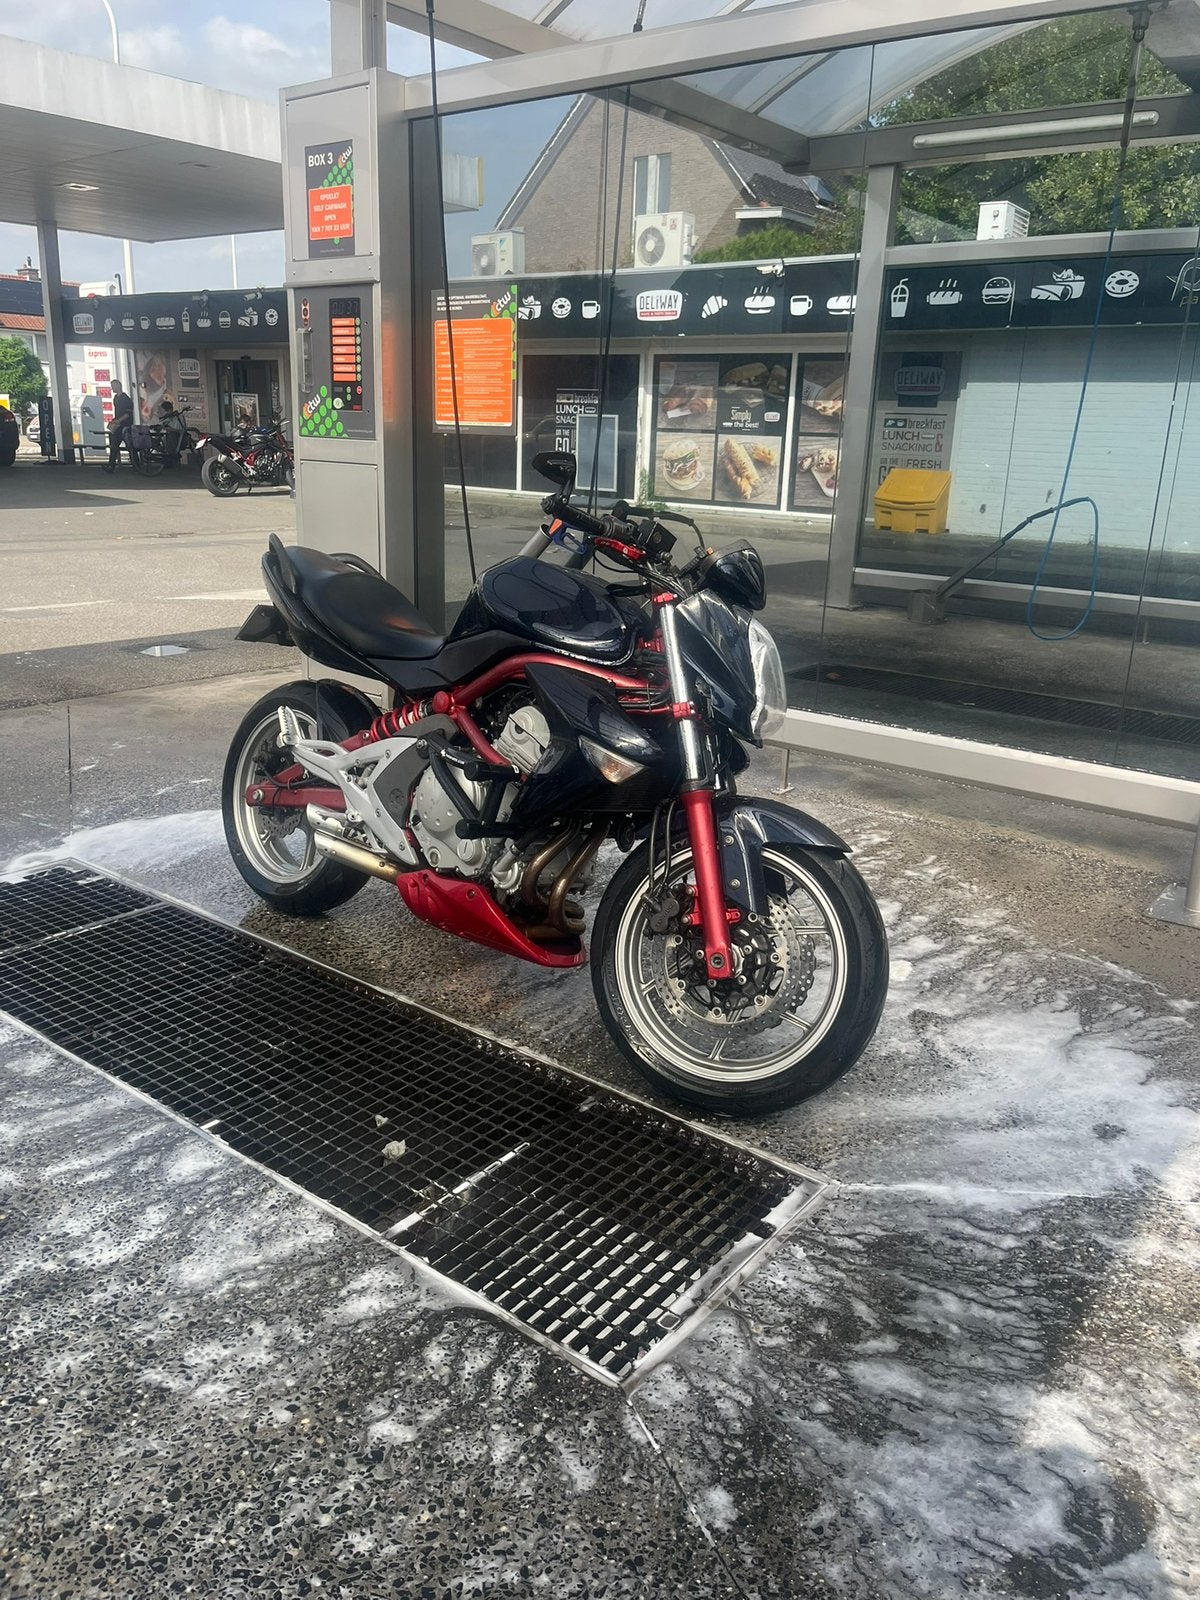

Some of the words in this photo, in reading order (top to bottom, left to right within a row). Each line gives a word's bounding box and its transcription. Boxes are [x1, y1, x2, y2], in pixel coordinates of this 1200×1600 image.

[308, 153, 326, 167] BOX
[327, 152, 334, 165] 3
[495, 291, 511, 312] ctw
[307, 394, 321, 414] ctw
[574, 393, 599, 404] breakfa
[555, 405, 584, 414] LUNCH
[555, 415, 577, 424] SNAC
[731, 409, 752, 423] Simply
[907, 418, 946, 430] breakfast
[882, 430, 920, 441] LUNCH
[881, 442, 933, 452] SNACKING
[906, 458, 942, 469] FRESH
